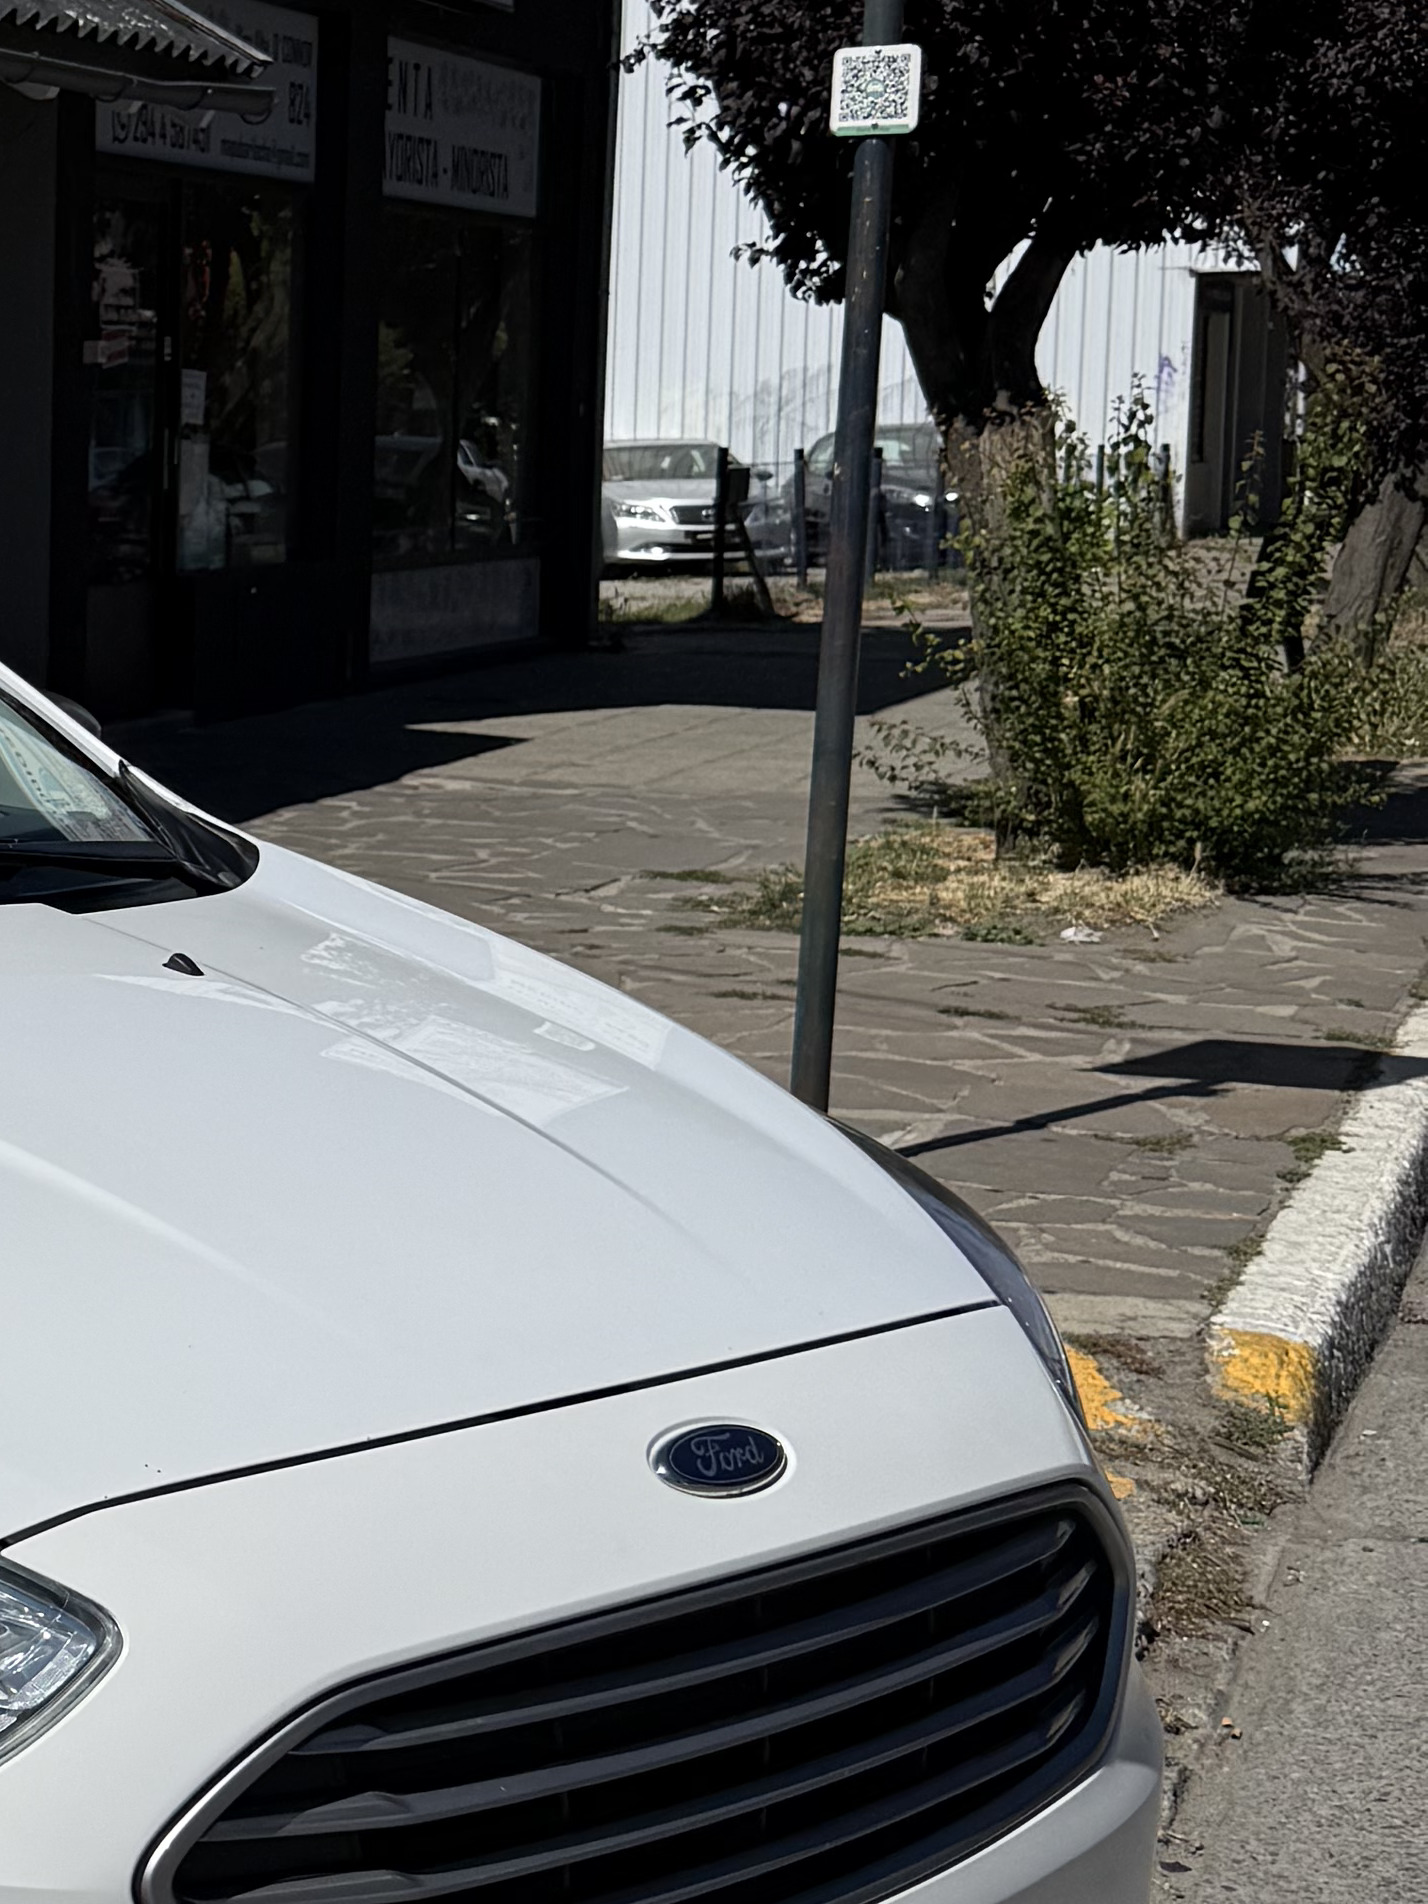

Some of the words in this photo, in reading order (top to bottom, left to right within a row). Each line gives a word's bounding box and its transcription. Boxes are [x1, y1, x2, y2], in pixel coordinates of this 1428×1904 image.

[383, 129, 439, 189] YORISTA
[451, 144, 509, 200] MINORISTA
[690, 1432, 765, 1477] Ford
